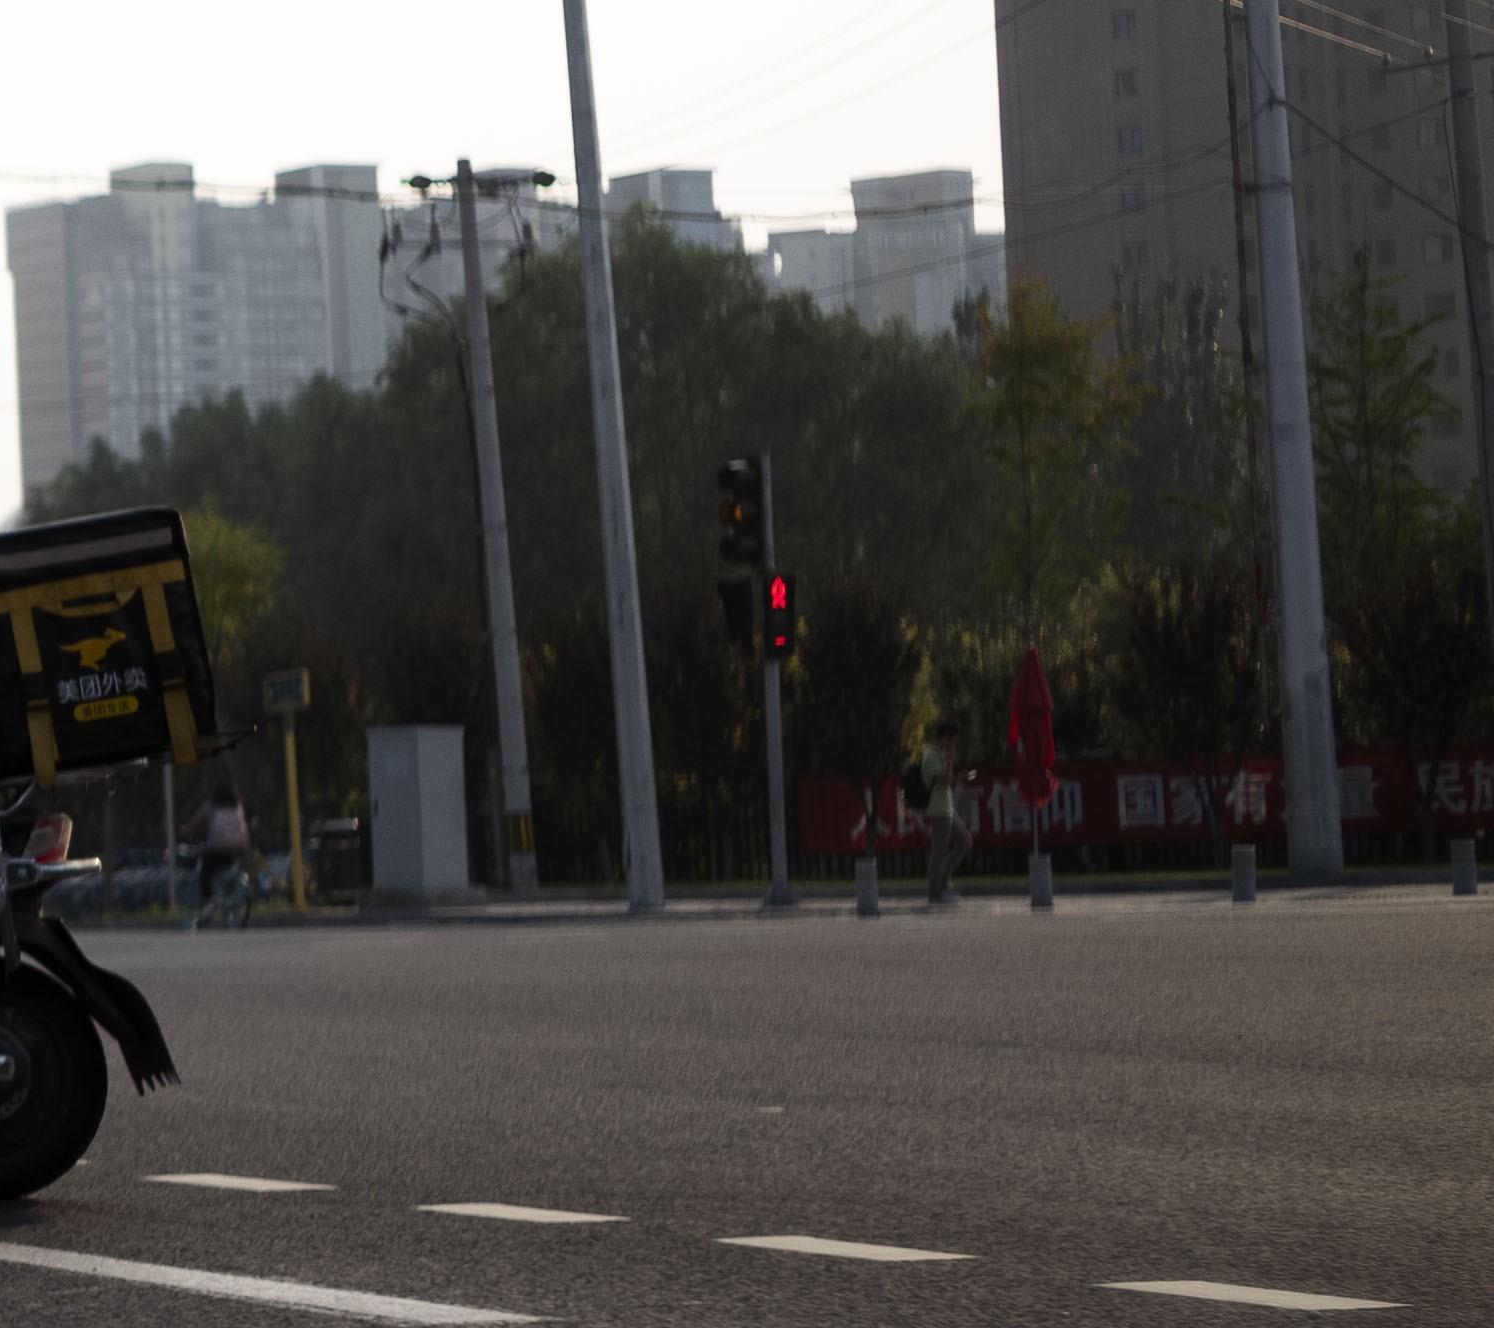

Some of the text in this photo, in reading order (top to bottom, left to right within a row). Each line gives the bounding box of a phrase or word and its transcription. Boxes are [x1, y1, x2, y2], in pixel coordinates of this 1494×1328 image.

[58, 665, 148, 704] 美团外卖
[1117, 764, 1381, 831] 国家有量
